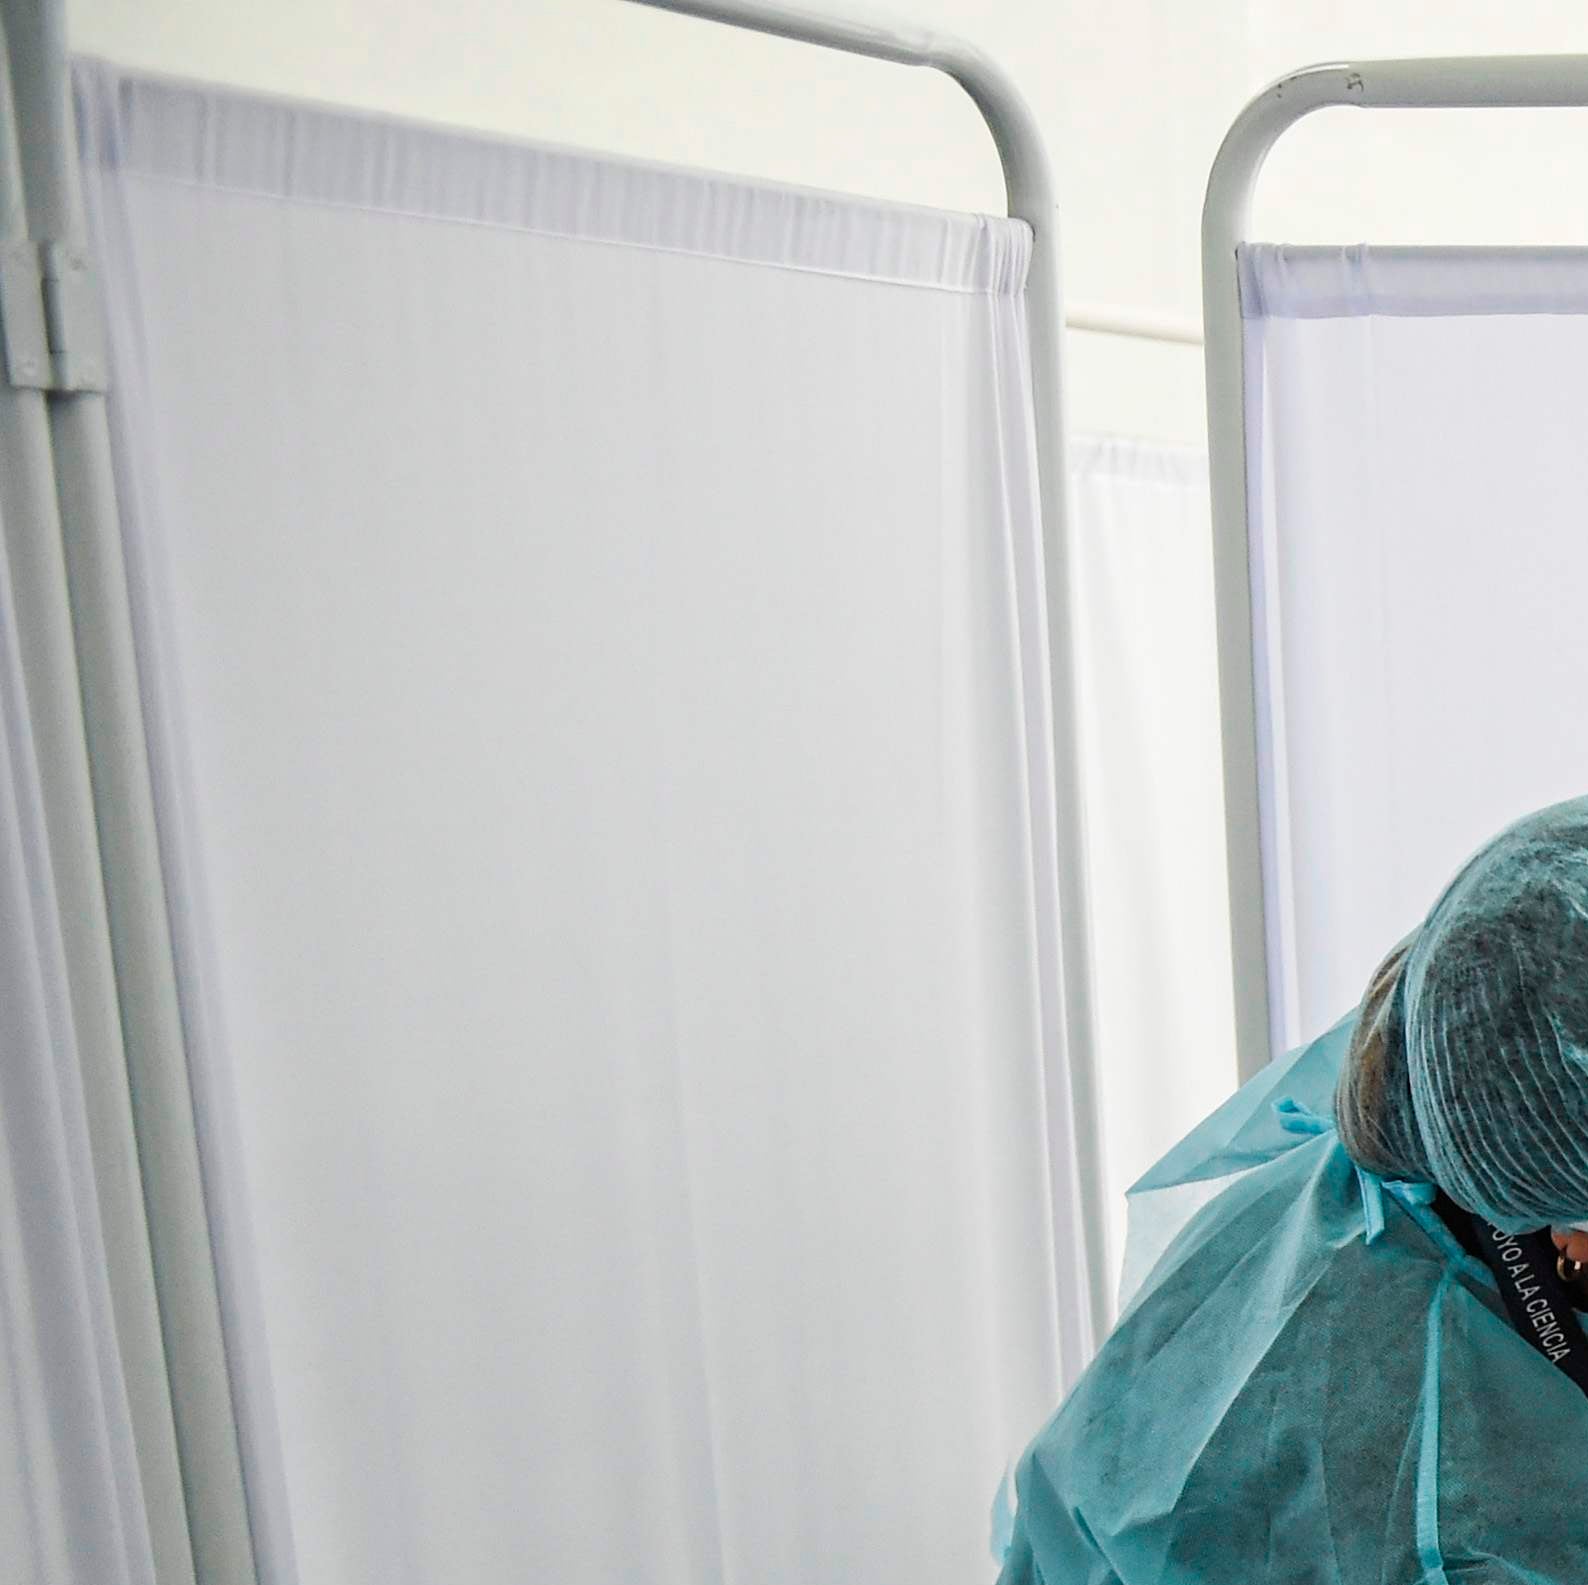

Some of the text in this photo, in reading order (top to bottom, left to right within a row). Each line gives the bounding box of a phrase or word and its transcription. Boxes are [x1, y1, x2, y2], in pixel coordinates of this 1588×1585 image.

[1488, 1222, 1571, 1364] OYO A LA CIENCIA
